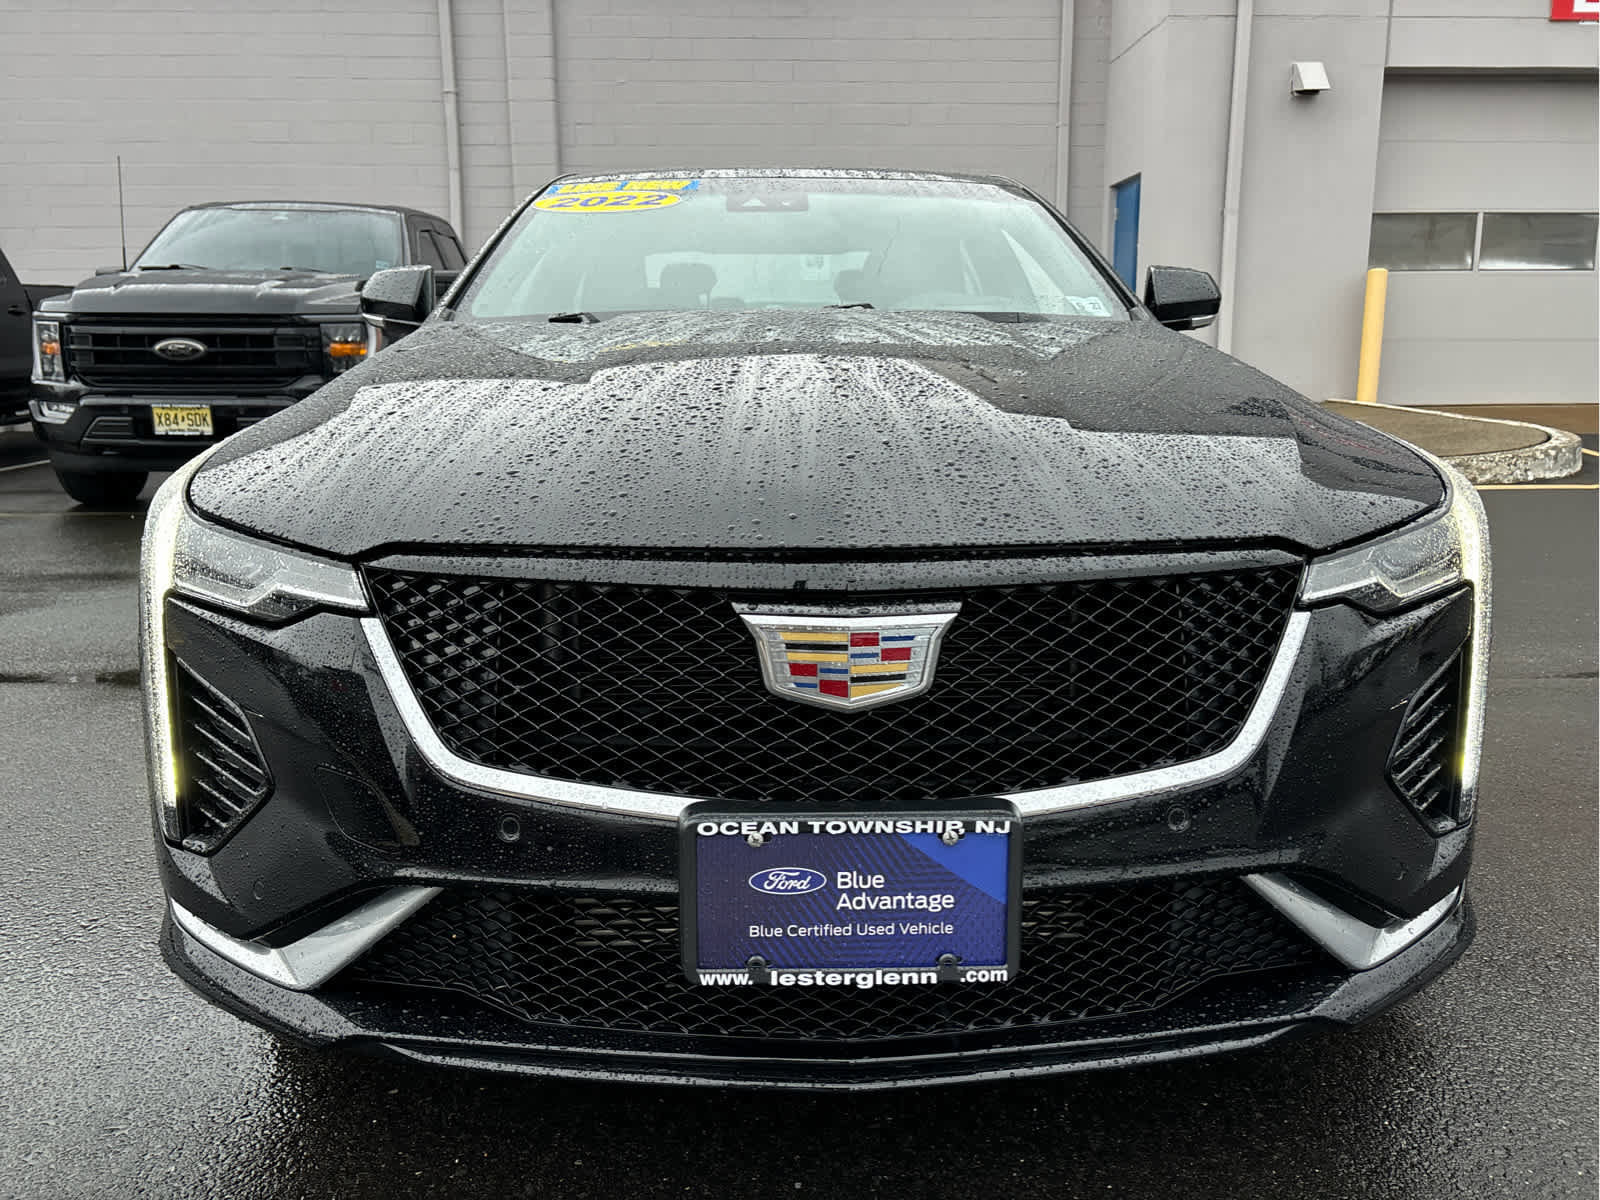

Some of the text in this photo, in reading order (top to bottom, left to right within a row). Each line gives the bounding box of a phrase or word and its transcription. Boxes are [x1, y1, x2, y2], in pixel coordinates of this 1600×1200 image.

[548, 194, 668, 208] 2022
[697, 821, 799, 836] OCEAN
[975, 820, 1011, 834] NJ
[763, 871, 811, 890] Ford
[837, 871, 885, 889] Blue
[836, 892, 955, 912] Advantage
[749, 922, 954, 938] Blue Certified Used Vehicle
[770, 970, 938, 989] lesterglenn
